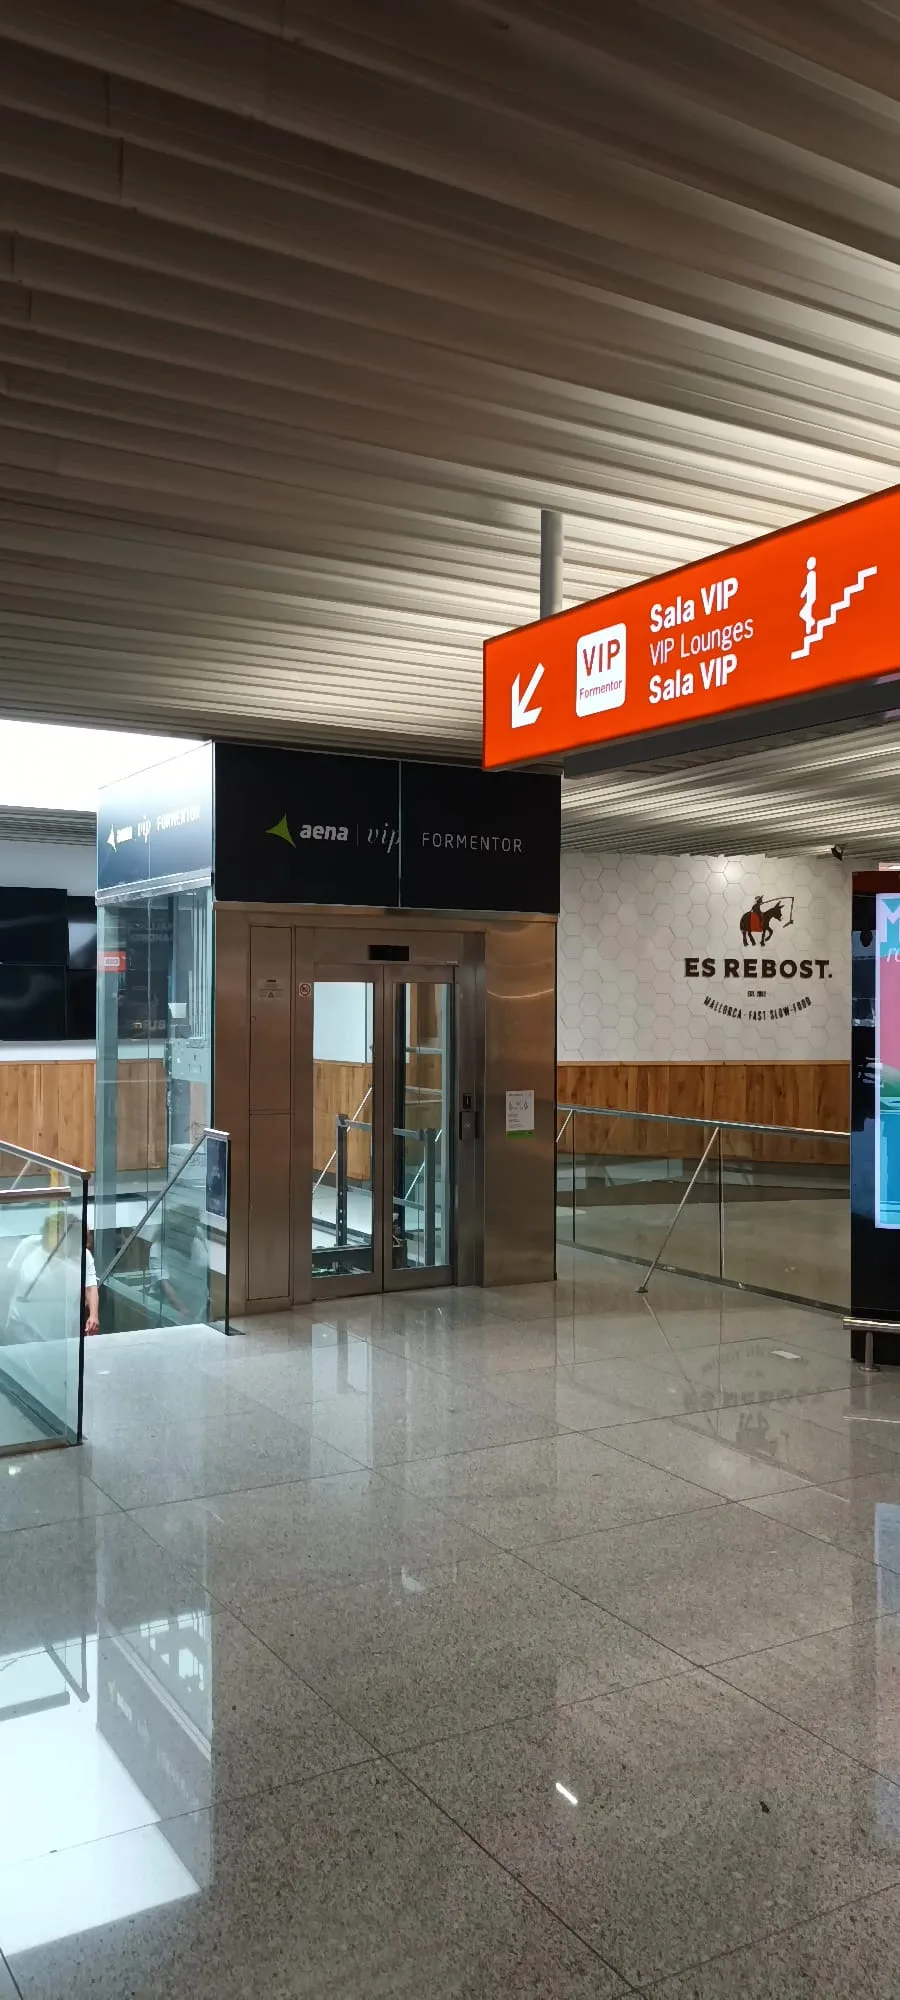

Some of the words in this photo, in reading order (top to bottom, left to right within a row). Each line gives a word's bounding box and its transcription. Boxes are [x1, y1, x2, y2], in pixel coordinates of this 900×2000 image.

[650, 596, 695, 633] Sala
[701, 577, 739, 616] VIP
[582, 638, 621, 676] VIP
[649, 638, 675, 666] VIP
[680, 618, 754, 658] Lounges
[579, 679, 623, 700] Formentor
[648, 669, 694, 704] Sala
[700, 653, 738, 689] VIP
[300, 824, 349, 841] aena
[367, 823, 400, 854] vip
[422, 832, 522, 853] FORMENTOR
[684, 957, 716, 978] ES
[724, 958, 833, 979] REBOST.
[703, 995, 742, 1020] MALLORCA
[748, 1010, 766, 1021] FAST
